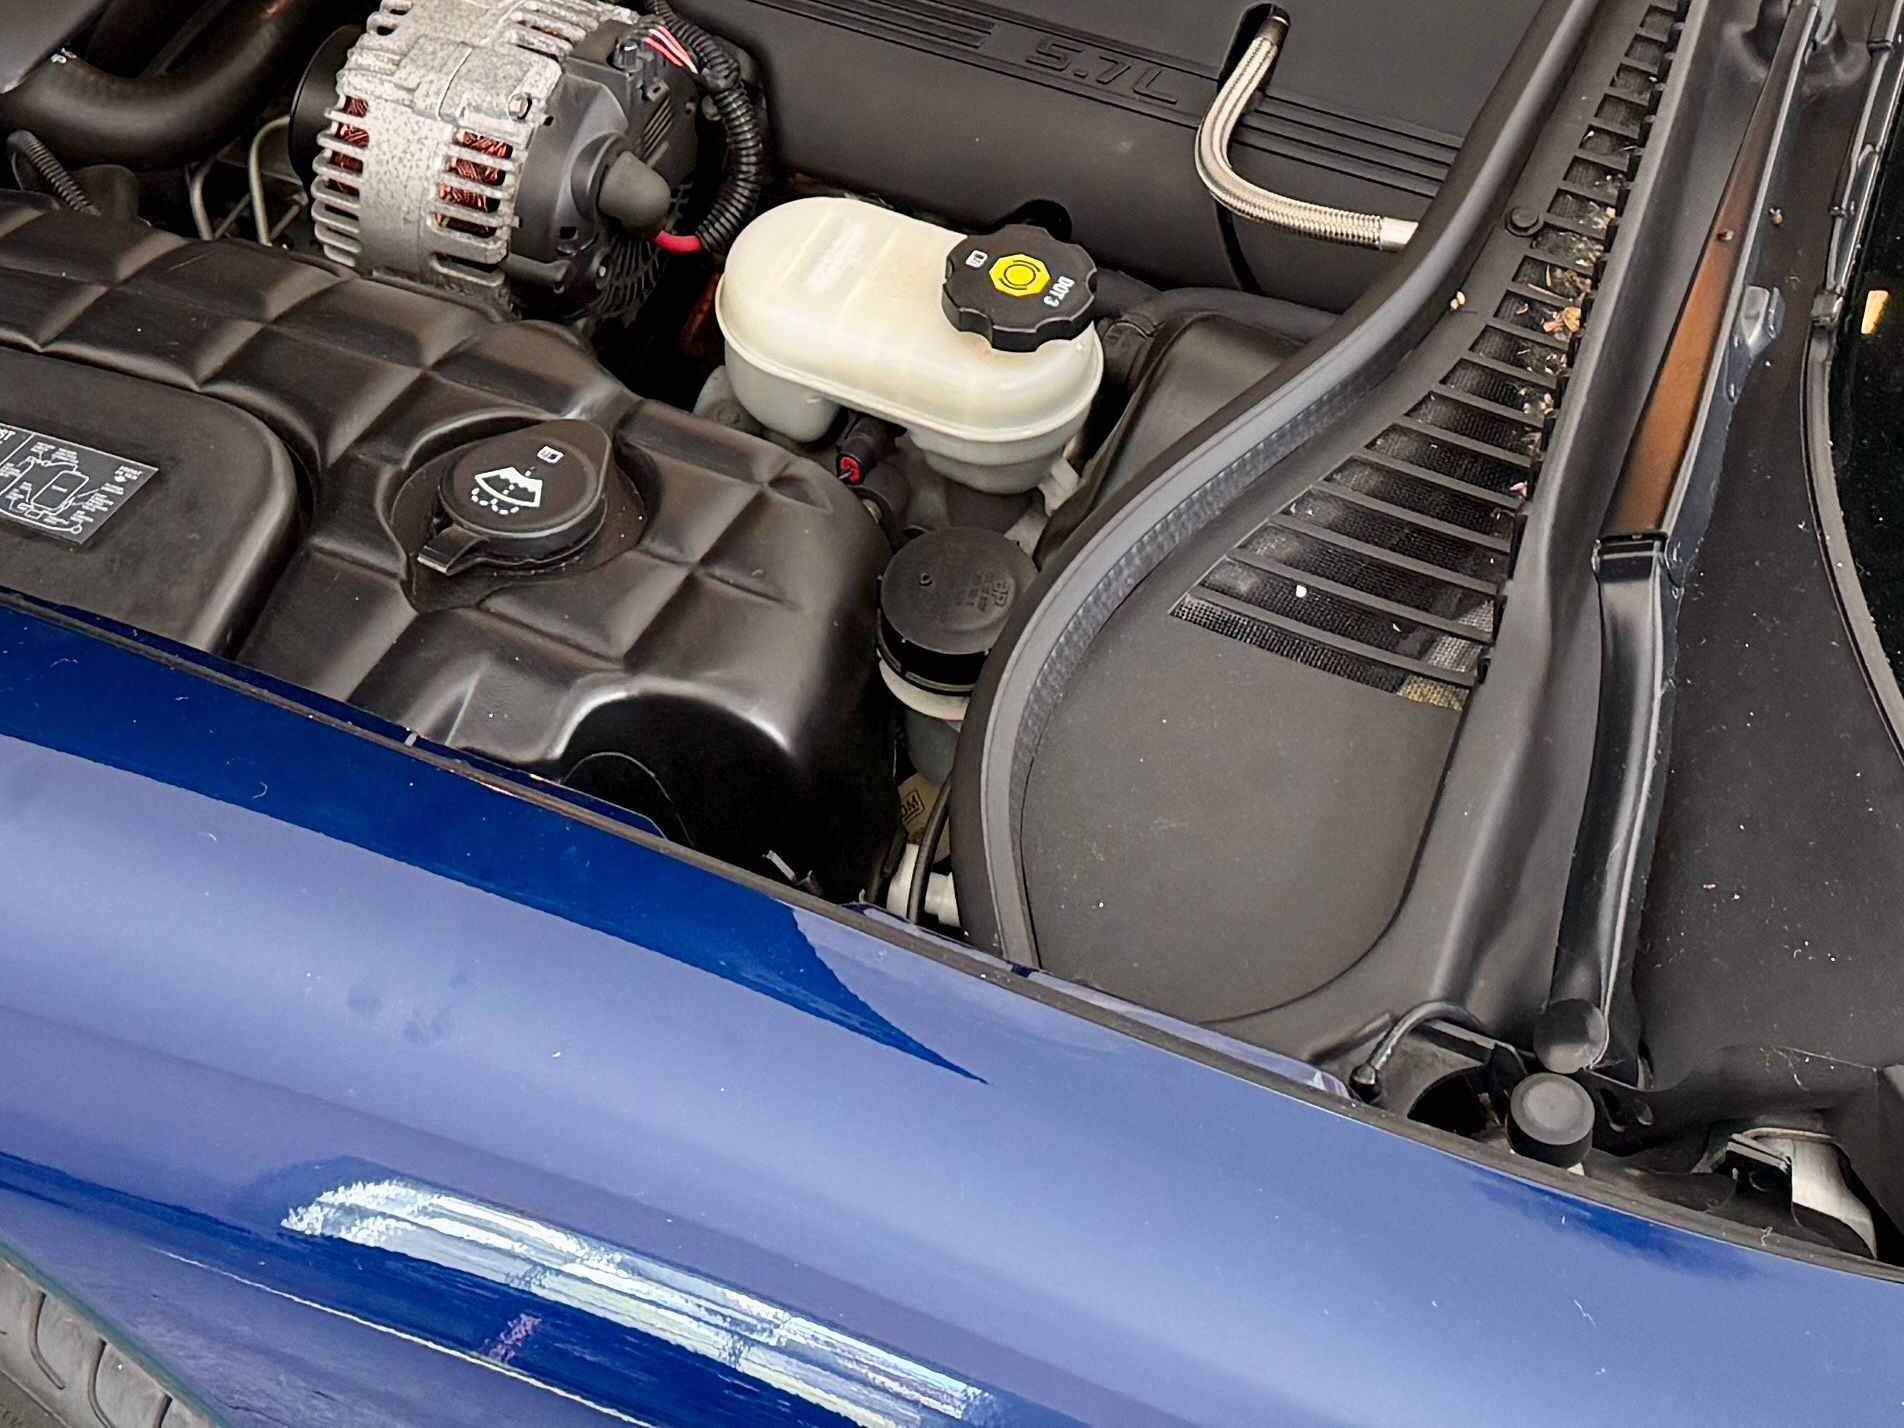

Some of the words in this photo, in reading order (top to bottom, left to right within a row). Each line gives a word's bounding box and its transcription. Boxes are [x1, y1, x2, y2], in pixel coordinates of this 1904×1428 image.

[1021, 30, 1185, 107] 5.7L
[1052, 275, 1076, 301] DOT
[1043, 295, 1060, 308] 3
